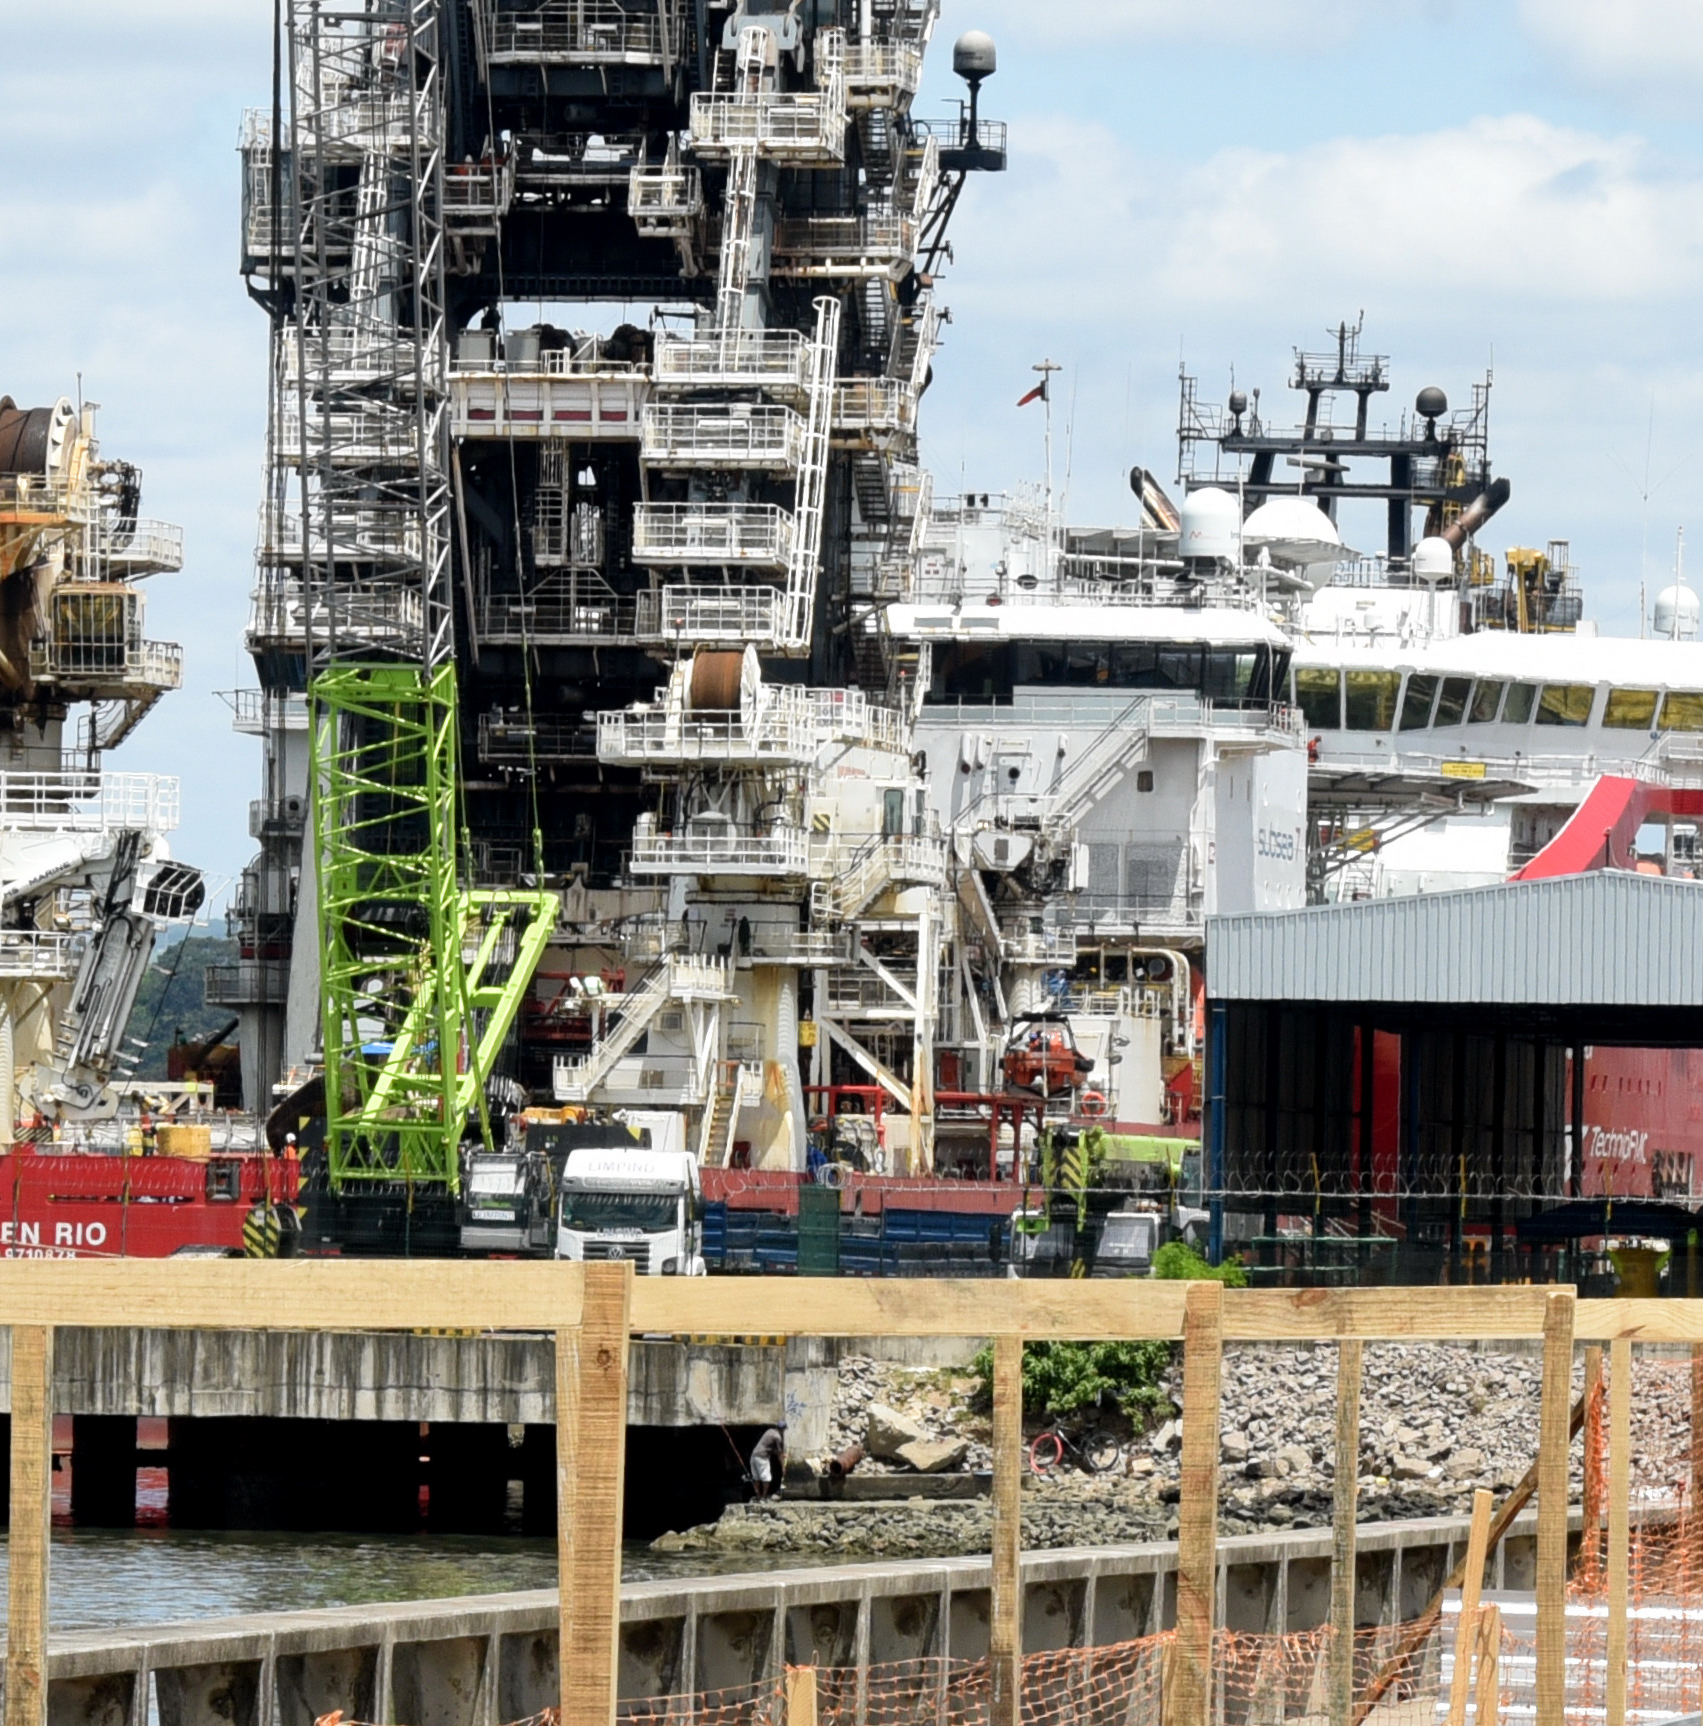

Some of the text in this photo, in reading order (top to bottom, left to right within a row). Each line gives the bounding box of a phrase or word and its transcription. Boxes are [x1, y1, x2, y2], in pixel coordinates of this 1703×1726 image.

[1258, 821, 1293, 861] subsea
[28, 861, 71, 886] MARINE
[587, 1161, 656, 1174] LIMPIND
[55, 1221, 107, 1246] RIO
